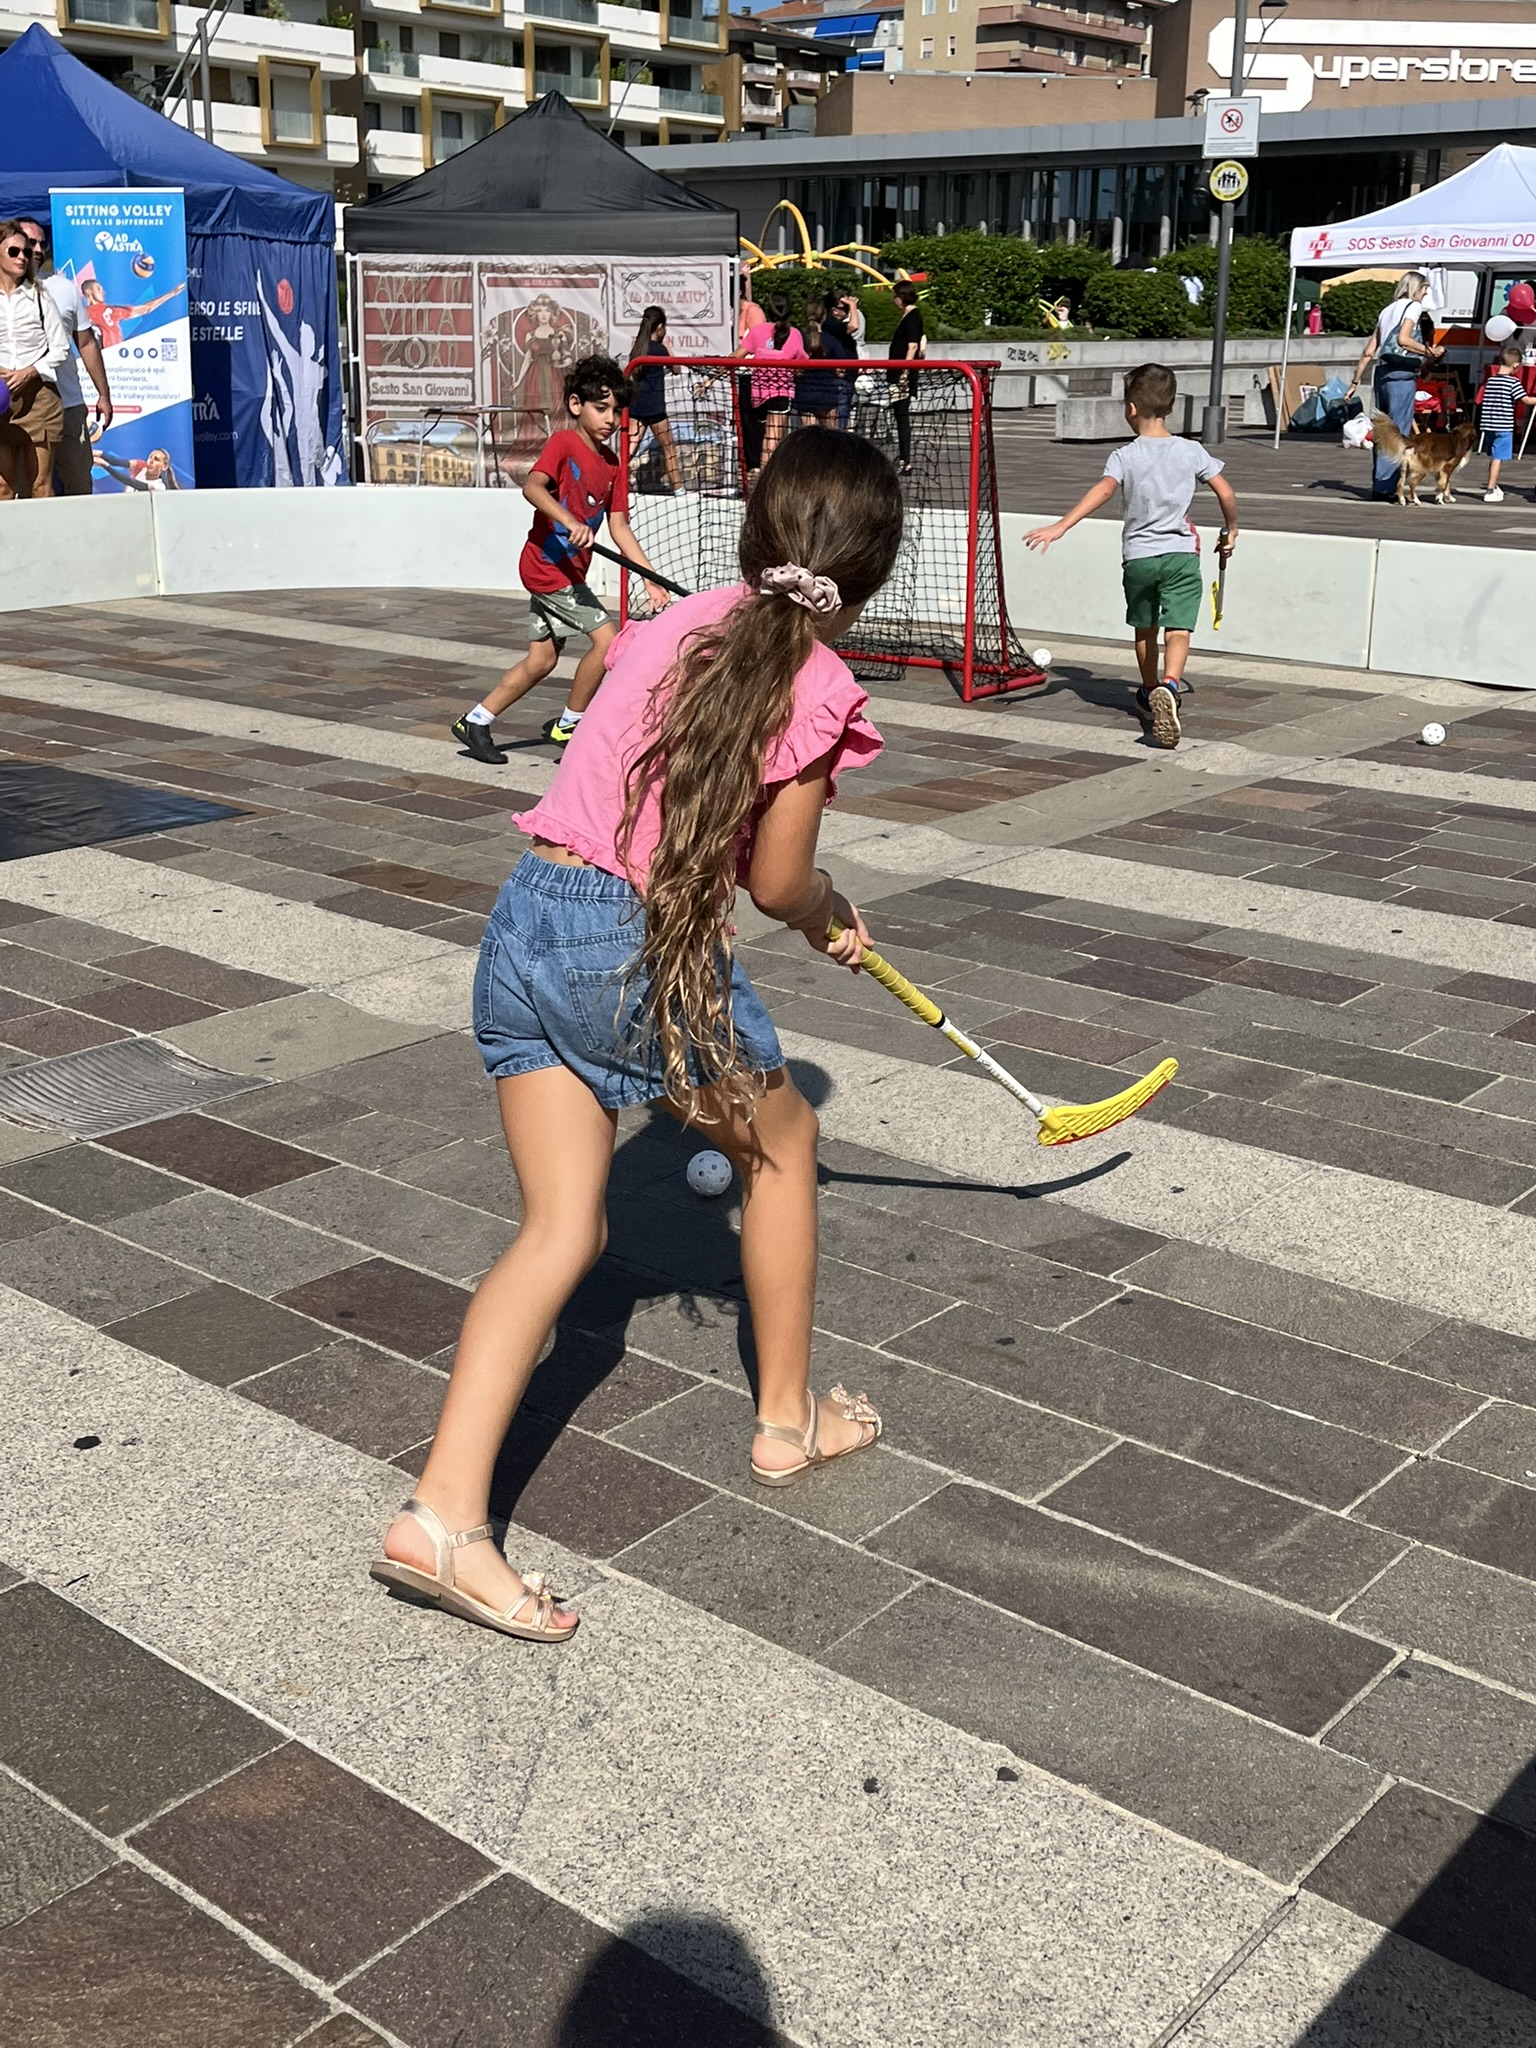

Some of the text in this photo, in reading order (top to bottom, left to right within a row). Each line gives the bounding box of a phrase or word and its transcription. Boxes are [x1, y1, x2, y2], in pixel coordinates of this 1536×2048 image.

[65, 204, 173, 217] SITTING VOLLEY
[71, 218, 164, 226] ESALTA LE DIFFERENZE
[115, 233, 129, 243] AD
[1347, 237, 1376, 251] SOS
[1379, 236, 1416, 250] Sesto
[1419, 235, 1446, 249] San
[1449, 233, 1509, 249] Giovanni
[111, 240, 144, 252] ASTRA
[189, 301, 216, 317] ERSO
[217, 301, 231, 317] LE
[378, 308, 457, 335] VILLA
[678, 335, 710, 348] VILLA
[371, 382, 470, 397] Sesto San Giovanni
[192, 401, 220, 421] TRA
